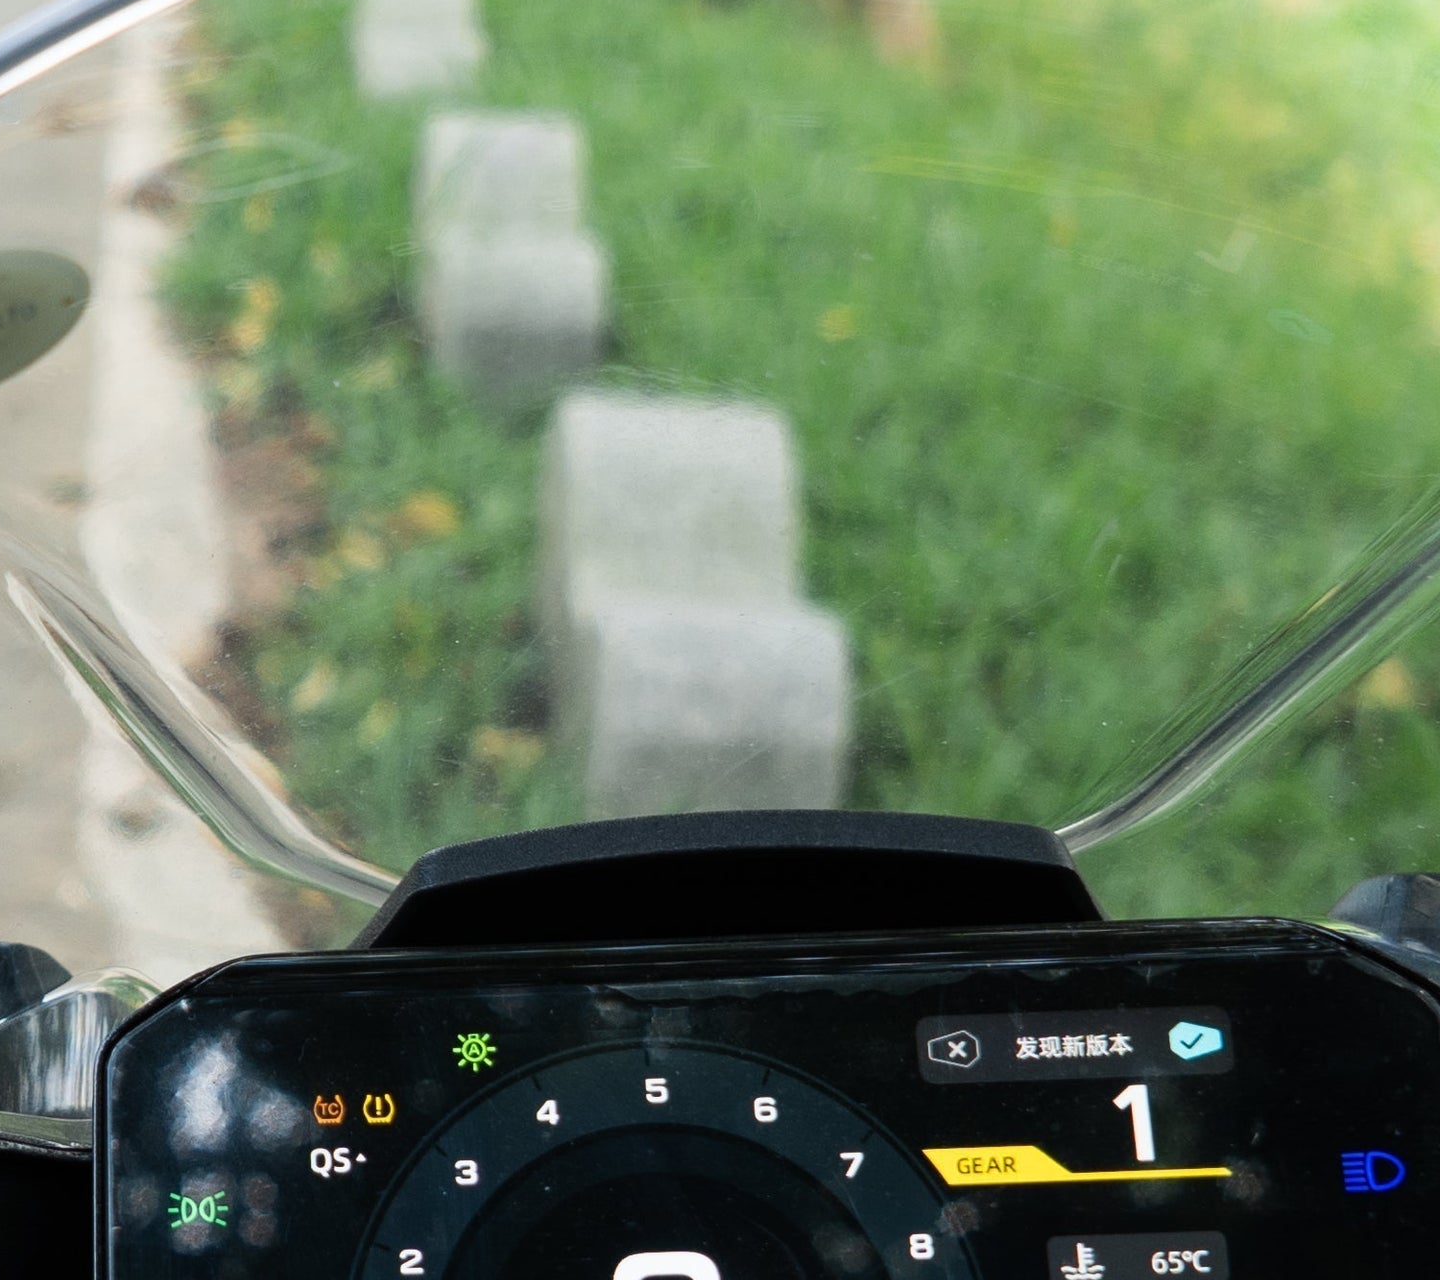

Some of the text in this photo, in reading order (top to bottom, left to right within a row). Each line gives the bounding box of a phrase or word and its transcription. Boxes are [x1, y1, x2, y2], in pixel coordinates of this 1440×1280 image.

[1015, 1032, 1134, 1060] 发现新版本
[644, 1077, 669, 1104] 5
[319, 1101, 339, 1117] TC
[535, 1099, 560, 1125] 4
[753, 1096, 779, 1123] 6
[1112, 1083, 1156, 1162] 1
[309, 1147, 352, 1178] QS
[454, 1159, 479, 1186] 3
[840, 1151, 865, 1179] 7
[956, 1156, 1017, 1175] GEAR
[908, 1232, 935, 1261] 8
[398, 1249, 424, 1275] 2
